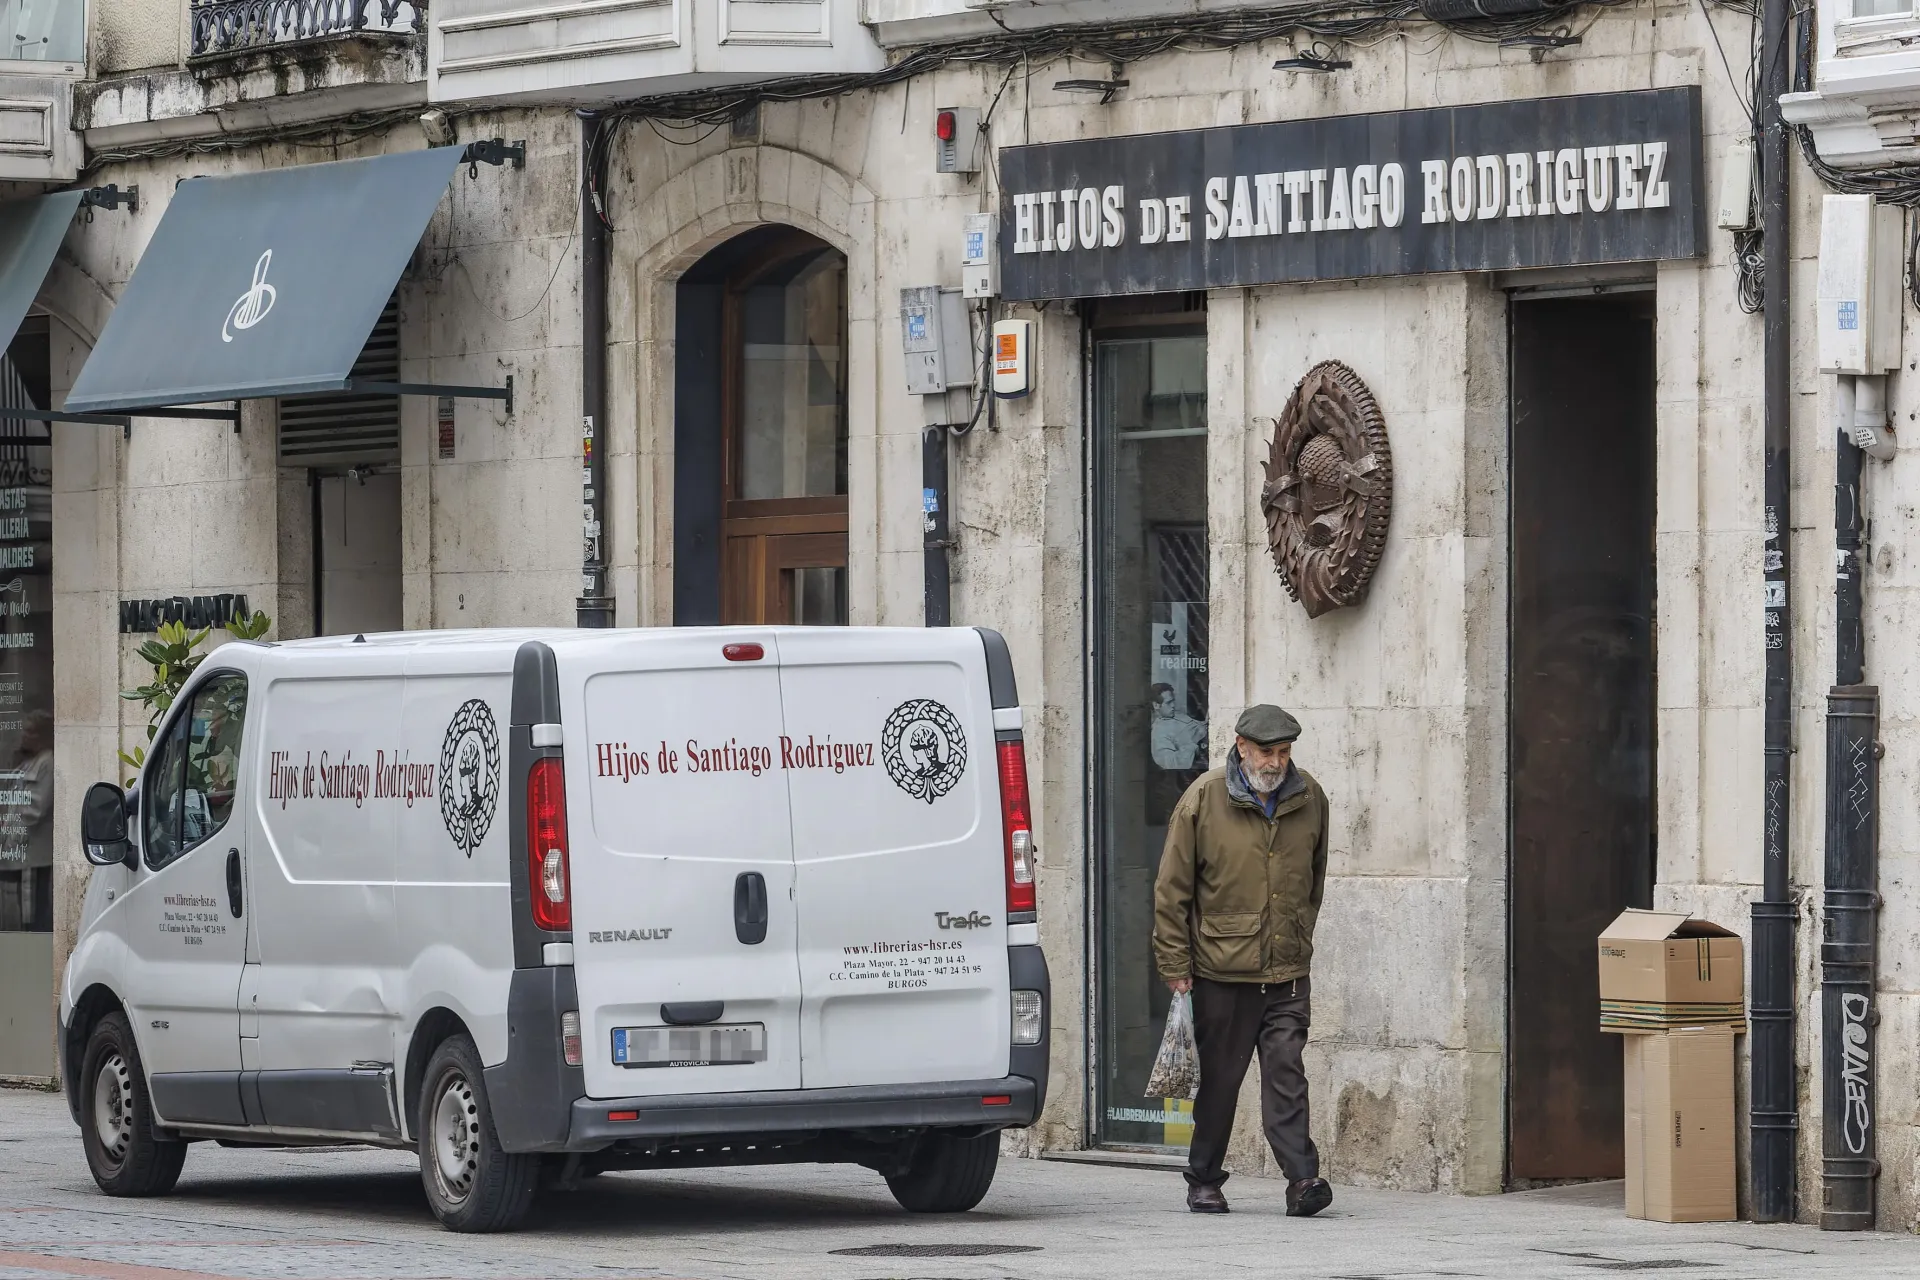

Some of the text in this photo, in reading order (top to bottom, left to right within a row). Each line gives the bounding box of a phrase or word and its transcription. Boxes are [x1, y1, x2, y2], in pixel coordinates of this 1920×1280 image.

[1013, 141, 1671, 254] HIJOS DE SANTIAGO RODRIGUEZ
[1160, 651, 1207, 673] reading
[596, 734, 875, 783] Hijos de Santiago Rodríguez
[268, 749, 434, 810] Hijos de Santiago Rodríguez
[934, 910, 992, 930] Trafic
[588, 928, 673, 943] RENAULT
[843, 939, 963, 955] www.librerias-hsr.es
[843, 961, 866, 969] Plaza
[899, 958, 908, 966] 22
[917, 957, 931, 965] 947
[934, 956, 943, 964] 20
[956, 955, 966, 963] 43
[829, 972, 847, 981] C.C.
[849, 970, 880, 980] Camino
[882, 970, 891, 978] de
[893, 969, 901, 977] la
[904, 968, 925, 977] Plata
[934, 967, 947, 975] 947
[950, 966, 959, 974] 24
[972, 965, 982, 973] 95
[887, 978, 928, 989] BURGOS
[618, 1049, 624, 1057] E
